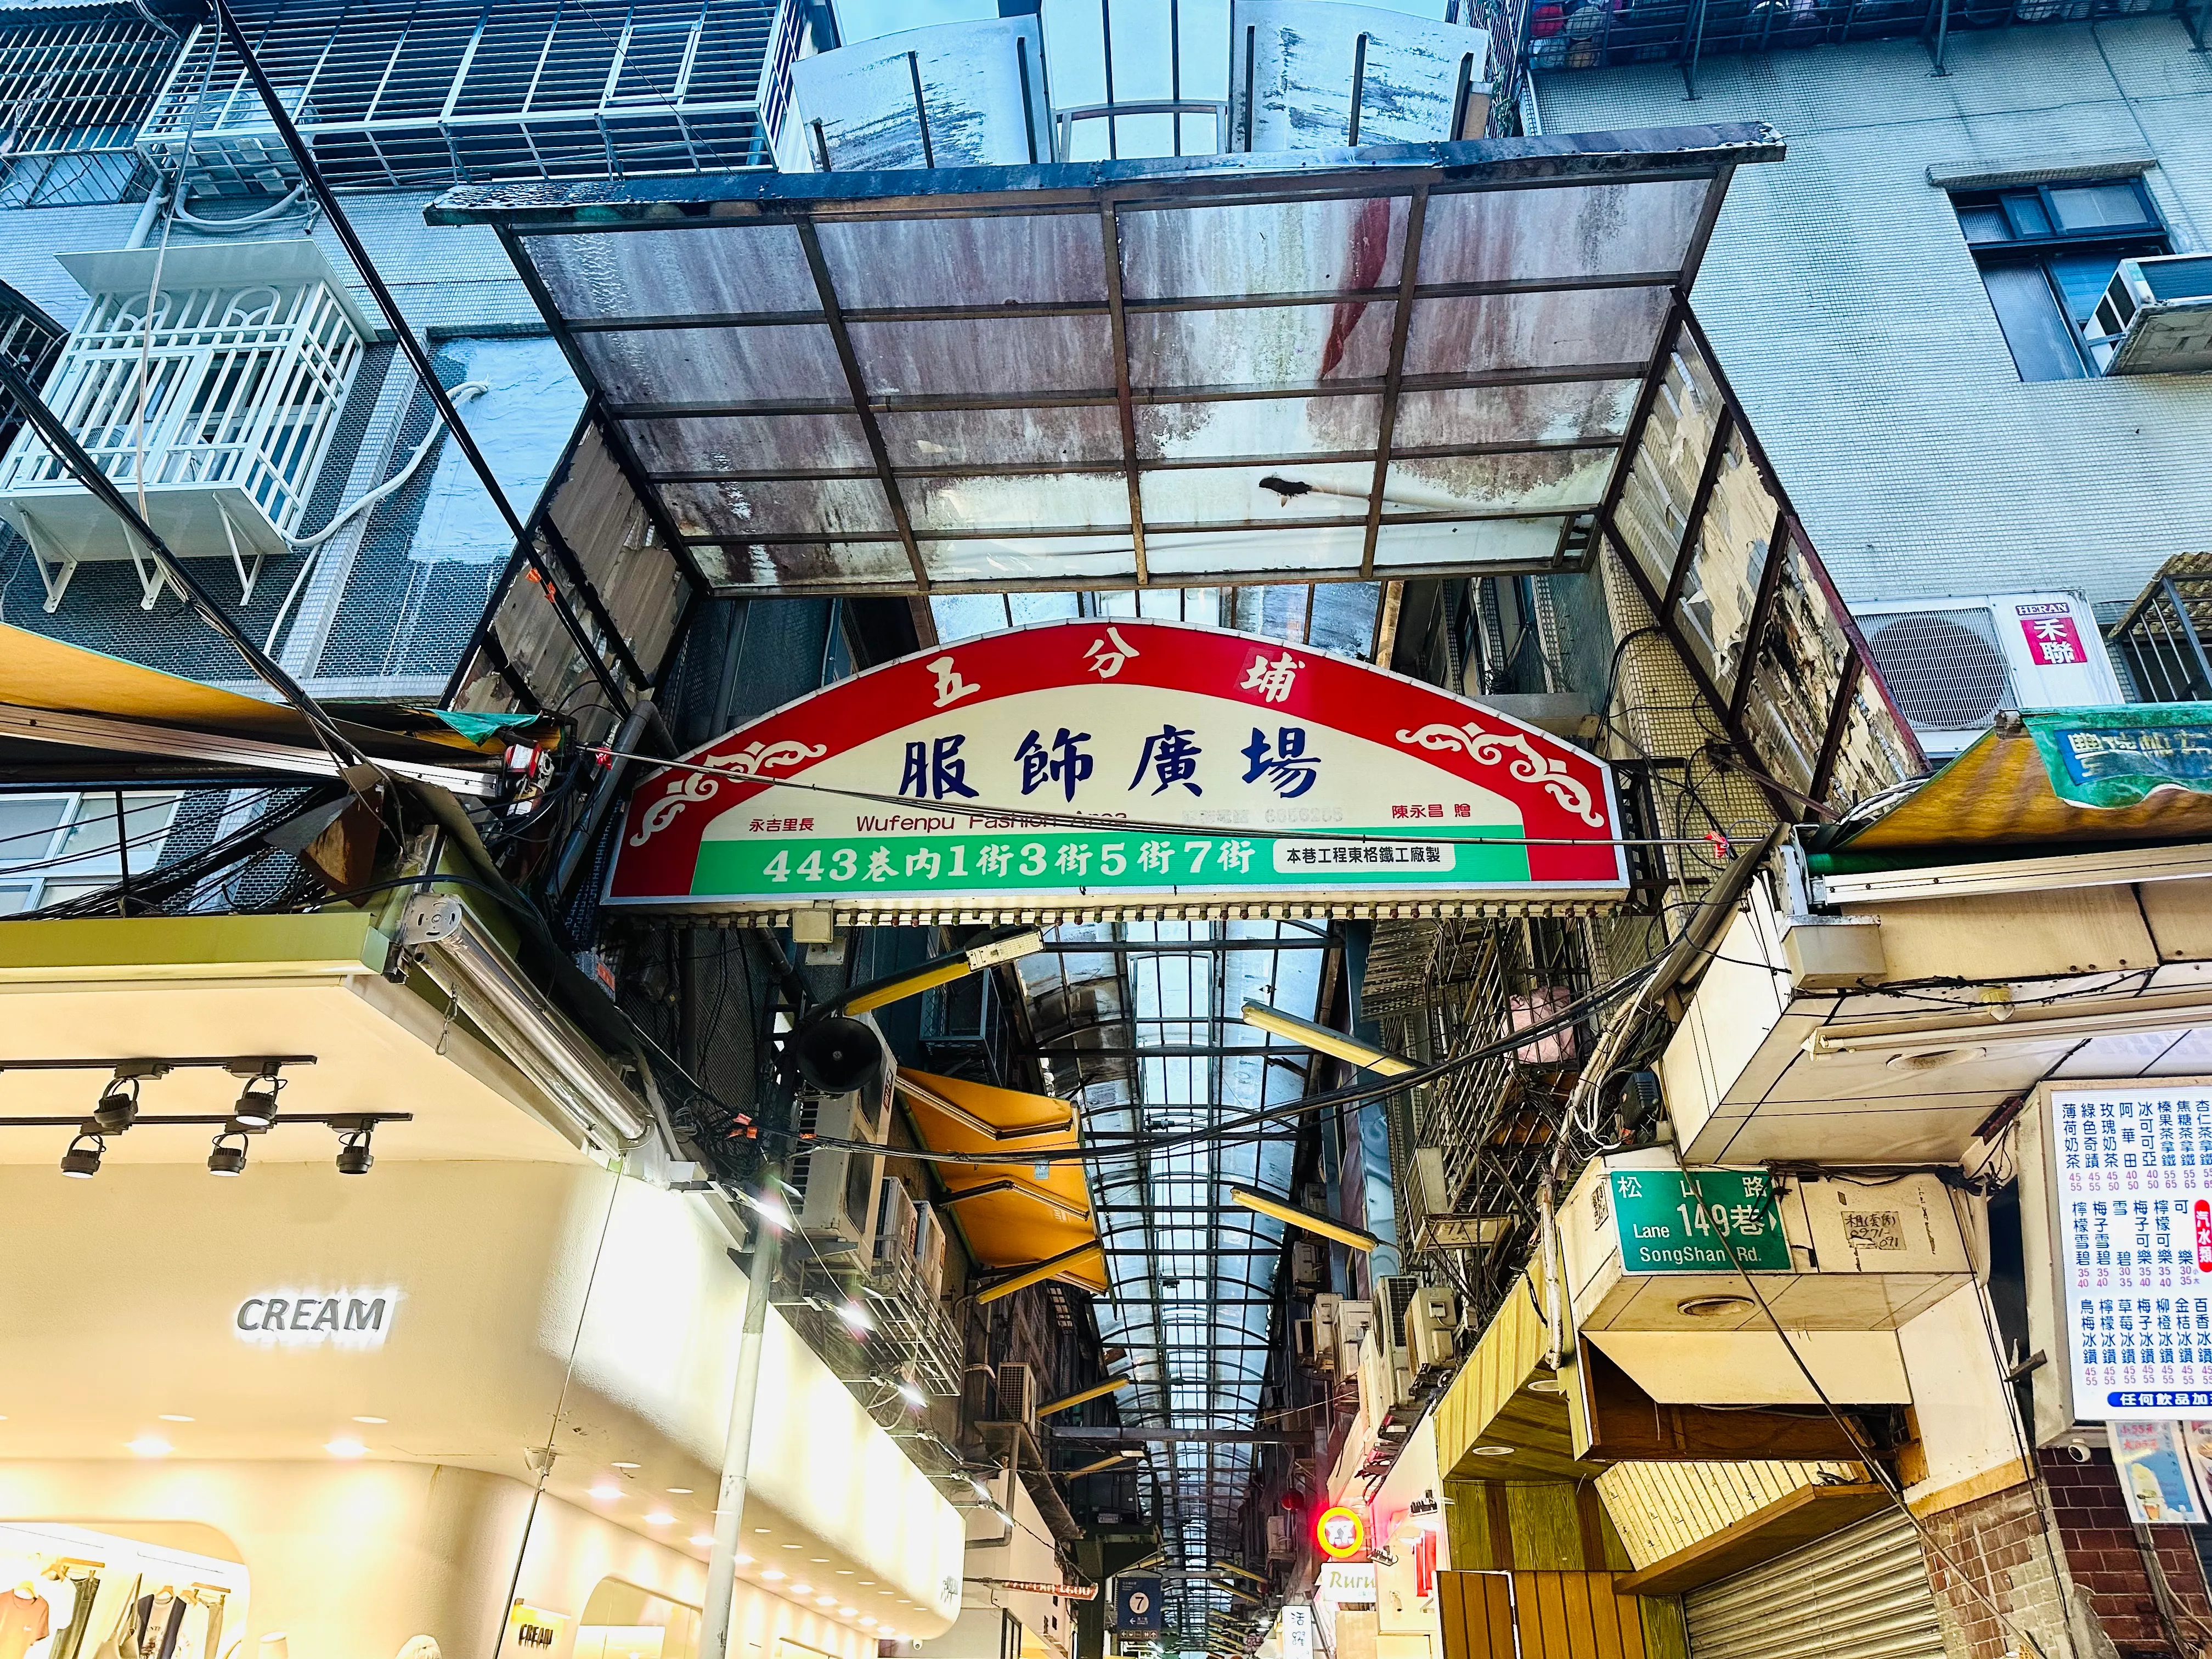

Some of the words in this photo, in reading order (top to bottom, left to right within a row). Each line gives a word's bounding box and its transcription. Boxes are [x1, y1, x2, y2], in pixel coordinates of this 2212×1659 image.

[2017, 603, 2067, 614] HERAN
[926, 627, 1305, 708] 五分埔
[2033, 618, 2075, 664] 禾聯
[899, 724, 1321, 803] 服飾廣場
[749, 817, 814, 832] 永吉里長
[856, 815, 955, 833] Wufenpu
[1392, 804, 1443, 819] 陳永昌
[1454, 803, 1471, 817] 贈
[1287, 846, 1441, 864] 本巷工程東格鐵工廠製
[2062, 1104, 2080, 1169] 薄荷奶茶
[2081, 1103, 2100, 1169] 綠色奇蹟
[2101, 1102, 2118, 1168] 玫瑰奶茶
[2120, 1103, 2137, 1167] 阿華田
[2138, 1102, 2157, 1166] 冰可可亞
[2157, 1101, 2176, 1166] 榛果茶拿鐵
[2176, 1101, 2195, 1166] 焦糖茶拿鐵
[2196, 1100, 2212, 1165] 杏仁茶拿鐵
[1617, 1176, 1768, 1198] 松山路
[2071, 1183, 2081, 1191] 55
[2109, 1182, 2119, 1190] 50
[2089, 1172, 2100, 1181] 45
[2126, 1171, 2137, 1179] 40
[1633, 1223, 1669, 1238] Lane
[1677, 1203, 1765, 1237] 149巷
[2072, 1201, 2090, 1266] 檸檬雪碧
[2093, 1201, 2111, 1265] 梅子雪碧
[2113, 1200, 2131, 1266] 雪碧
[2134, 1200, 2152, 1265] 梅子可樂
[2154, 1200, 2172, 1264] 檸檬可樂
[2174, 1200, 2193, 1265] 可樂
[2196, 1210, 2212, 1263] 汽水類
[1640, 1246, 1726, 1265] SongShan
[1736, 1246, 1762, 1262] Rd.
[2078, 1279, 2089, 1288] 40
[2097, 1278, 2107, 1286] 40
[2120, 1278, 2132, 1286] 35
[2140, 1278, 2150, 1286] 40
[2160, 1278, 2171, 1286] 40
[2180, 1277, 2191, 1285] 35
[2097, 1268, 2108, 1277] 35
[2119, 1267, 2130, 1276] 30
[2140, 1267, 2151, 1276] 35
[2159, 1267, 2170, 1275] 35
[2180, 1266, 2191, 1274] 30
[238, 1299, 386, 1331] CREAM
[2099, 1299, 2117, 1364] 檸檬冰鑽
[2118, 1299, 2136, 1364] 草莓冰鑽
[2137, 1298, 2155, 1364] 梅子冰鑽
[2156, 1298, 2175, 1363] 柳橙冰鑽
[2175, 1298, 2193, 1363] 金桔冰鑽
[2194, 1297, 2212, 1363] 百香冰鑽
[2104, 1367, 2115, 1375] 45
[2124, 1366, 2135, 1374] 45
[2162, 1365, 2172, 1374] 45
[2182, 1365, 2192, 1374] 45
[2104, 1376, 2115, 1385] 55
[2124, 1375, 2136, 1384] 55
[2143, 1375, 2154, 1383] 55
[2163, 1375, 2174, 1384] 55
[2183, 1376, 2194, 1384] 55
[2120, 1392, 2212, 1406] 任何飲品加
[1135, 1596, 1144, 1610] 7
